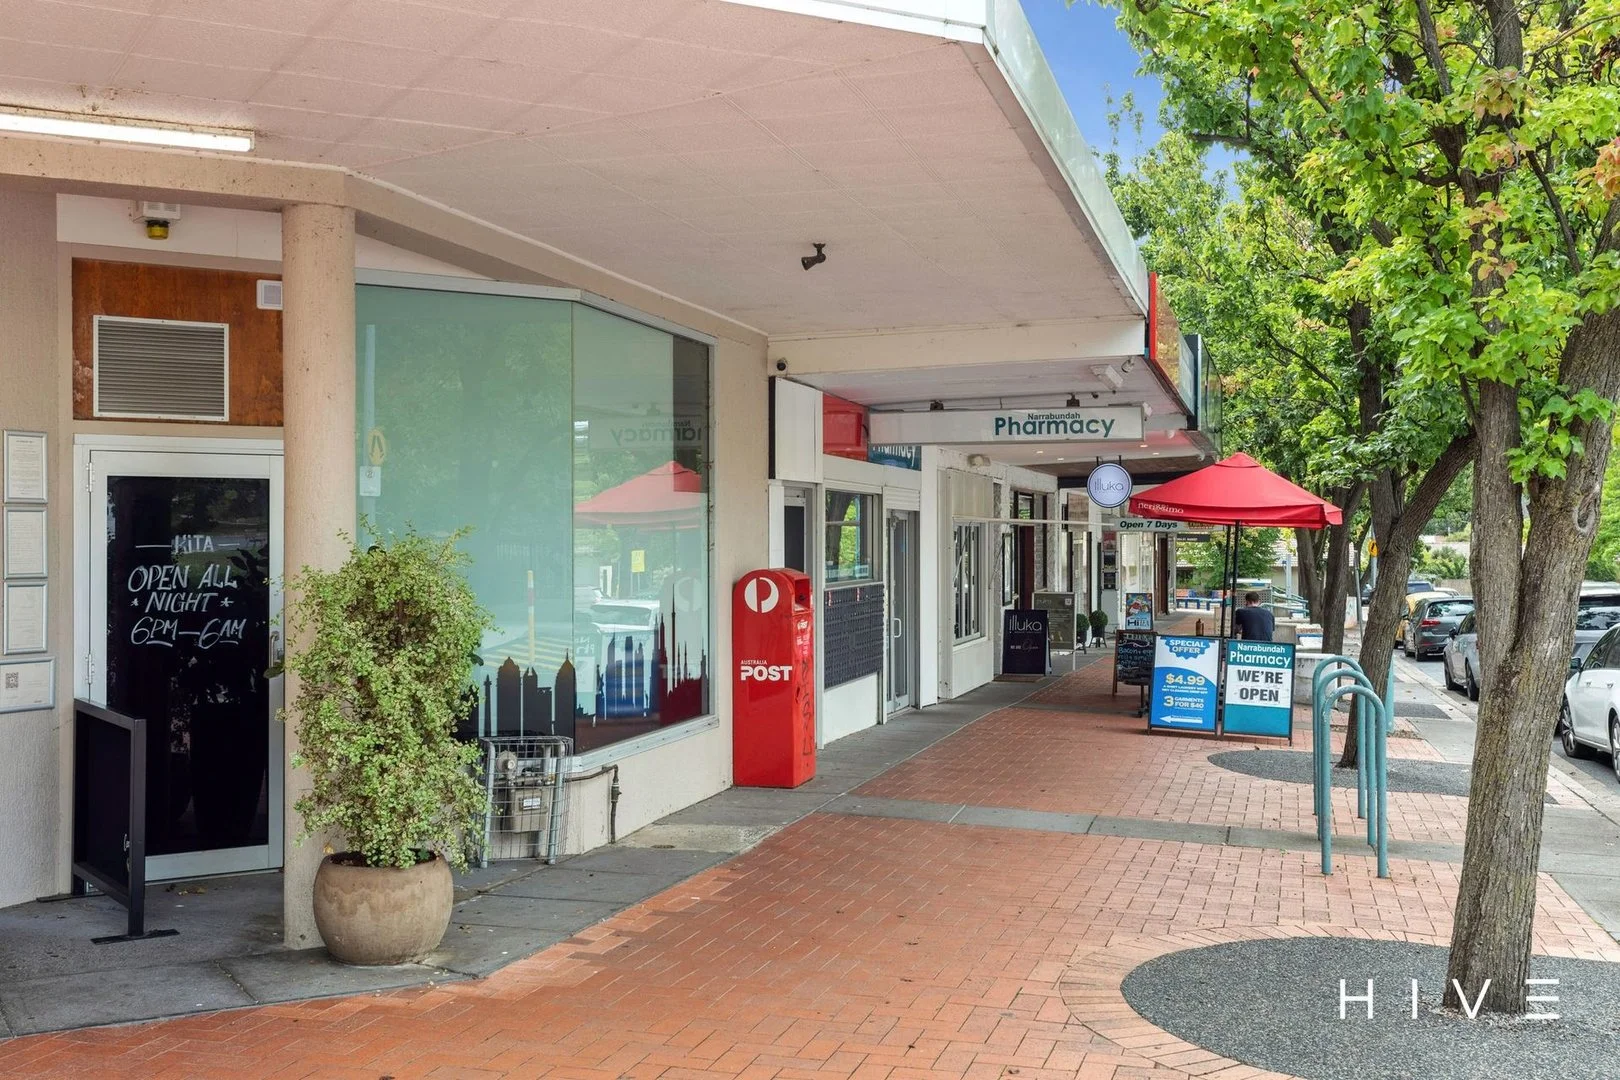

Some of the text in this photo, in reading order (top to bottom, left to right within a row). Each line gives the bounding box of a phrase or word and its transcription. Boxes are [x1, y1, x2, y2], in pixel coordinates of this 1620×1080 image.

[1028, 412, 1080, 421] Narrabundah
[994, 416, 1115, 438] Pharmacy
[1119, 520, 1144, 529] Open
[1146, 520, 1152, 528] 7
[1155, 521, 1178, 530] Days
[127, 563, 238, 592] OPEN ALL
[144, 591, 219, 614] NIGHT
[1170, 639, 1206, 648] SPECIAL
[1172, 646, 1201, 654] OFFER
[1238, 642, 1286, 654] Narrabundah
[1229, 650, 1291, 669] Pharmacy
[740, 665, 793, 682] POST
[1166, 673, 1206, 686] $4.99
[1237, 669, 1284, 685] WE'RE
[1163, 695, 1174, 707] 3
[1239, 687, 1280, 703] OPEN
